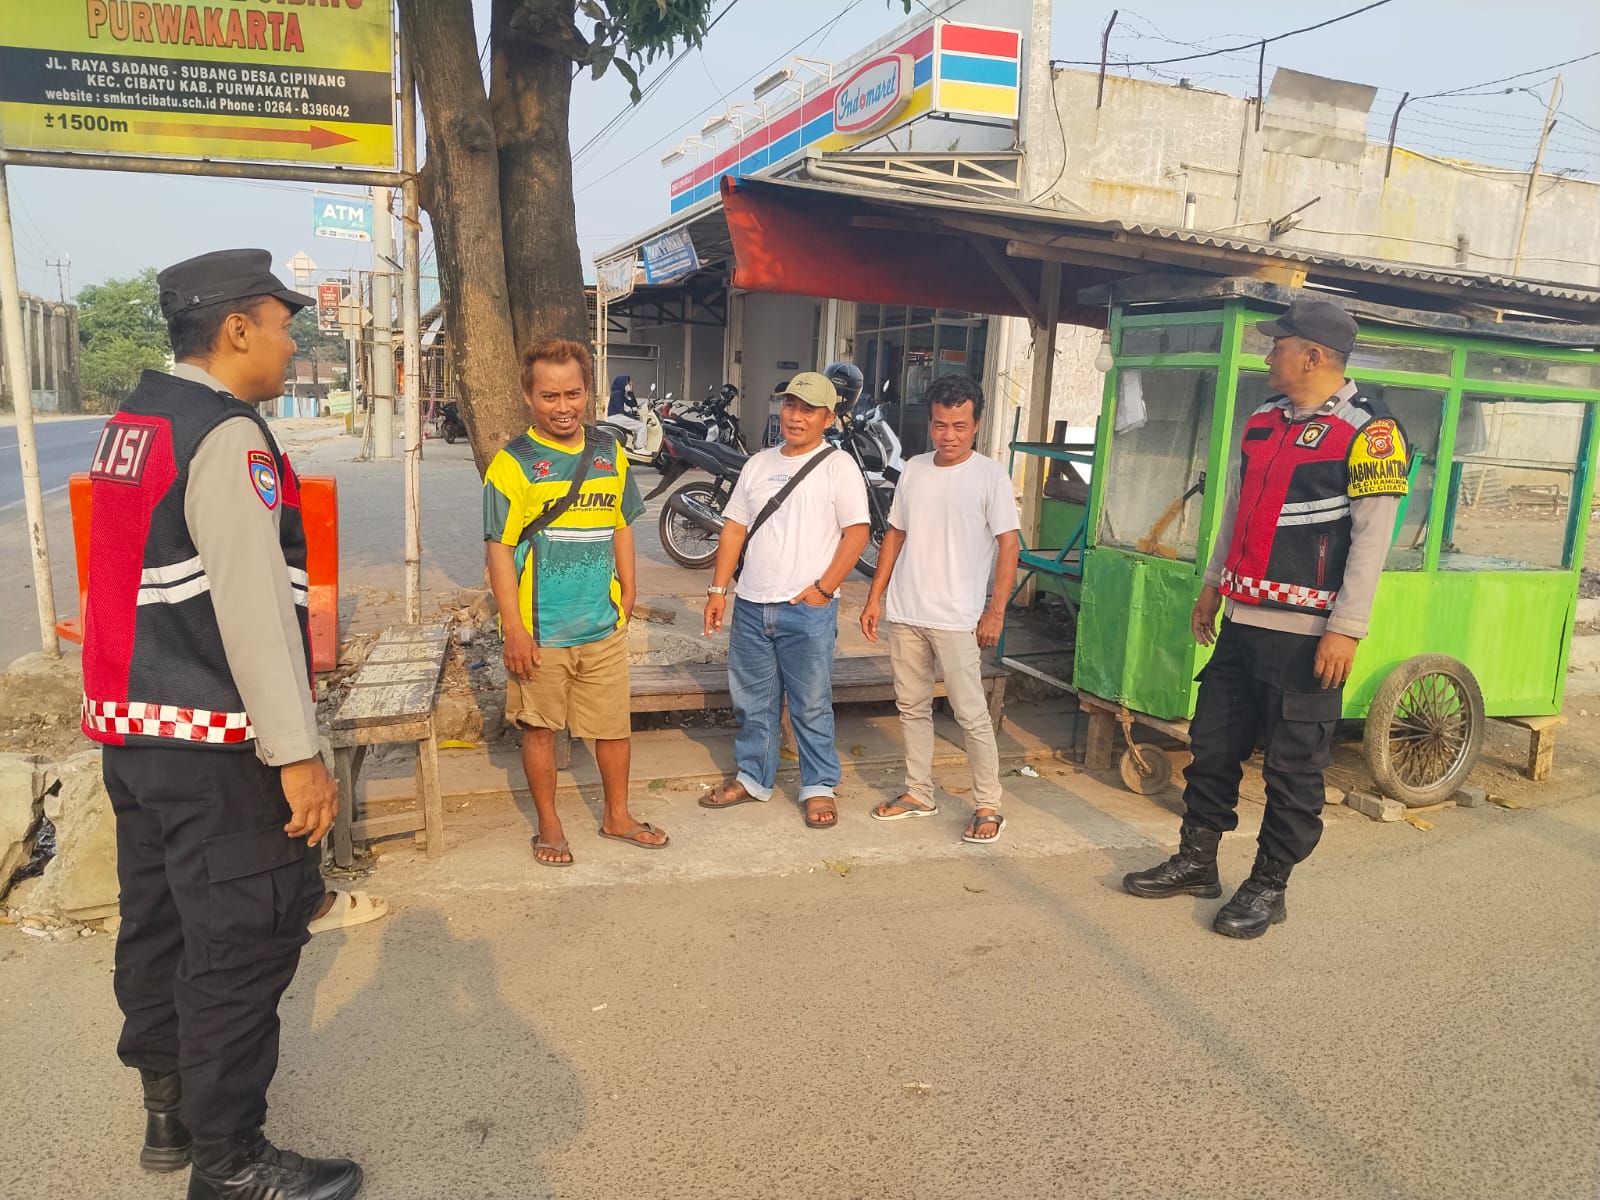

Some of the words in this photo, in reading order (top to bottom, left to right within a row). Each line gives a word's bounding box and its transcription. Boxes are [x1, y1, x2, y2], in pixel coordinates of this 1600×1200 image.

[86, 0, 304, 52] PURWAKARTA
[45, 57, 67, 71] JL.
[71, 58, 108, 74] RAYA
[112, 61, 168, 78] SADANG
[181, 65, 236, 82] SUBANG
[241, 69, 276, 84] DESA
[280, 71, 346, 88] CIPINANG
[87, 74, 119, 88] KEC.
[124, 76, 175, 92] CIBATU
[180, 79, 212, 95] KAB.
[216, 82, 310, 100] PURWAKARTA
[45, 88, 93, 103] website
[103, 91, 217, 109] smkn1cibatu.sch.id
[220, 99, 255, 113] Phone
[264, 101, 291, 115] 0264
[302, 103, 350, 118] 8396042
[838, 65, 897, 120] Indomaret
[45, 112, 128, 133] ±1500m
[323, 204, 363, 222] ATM
